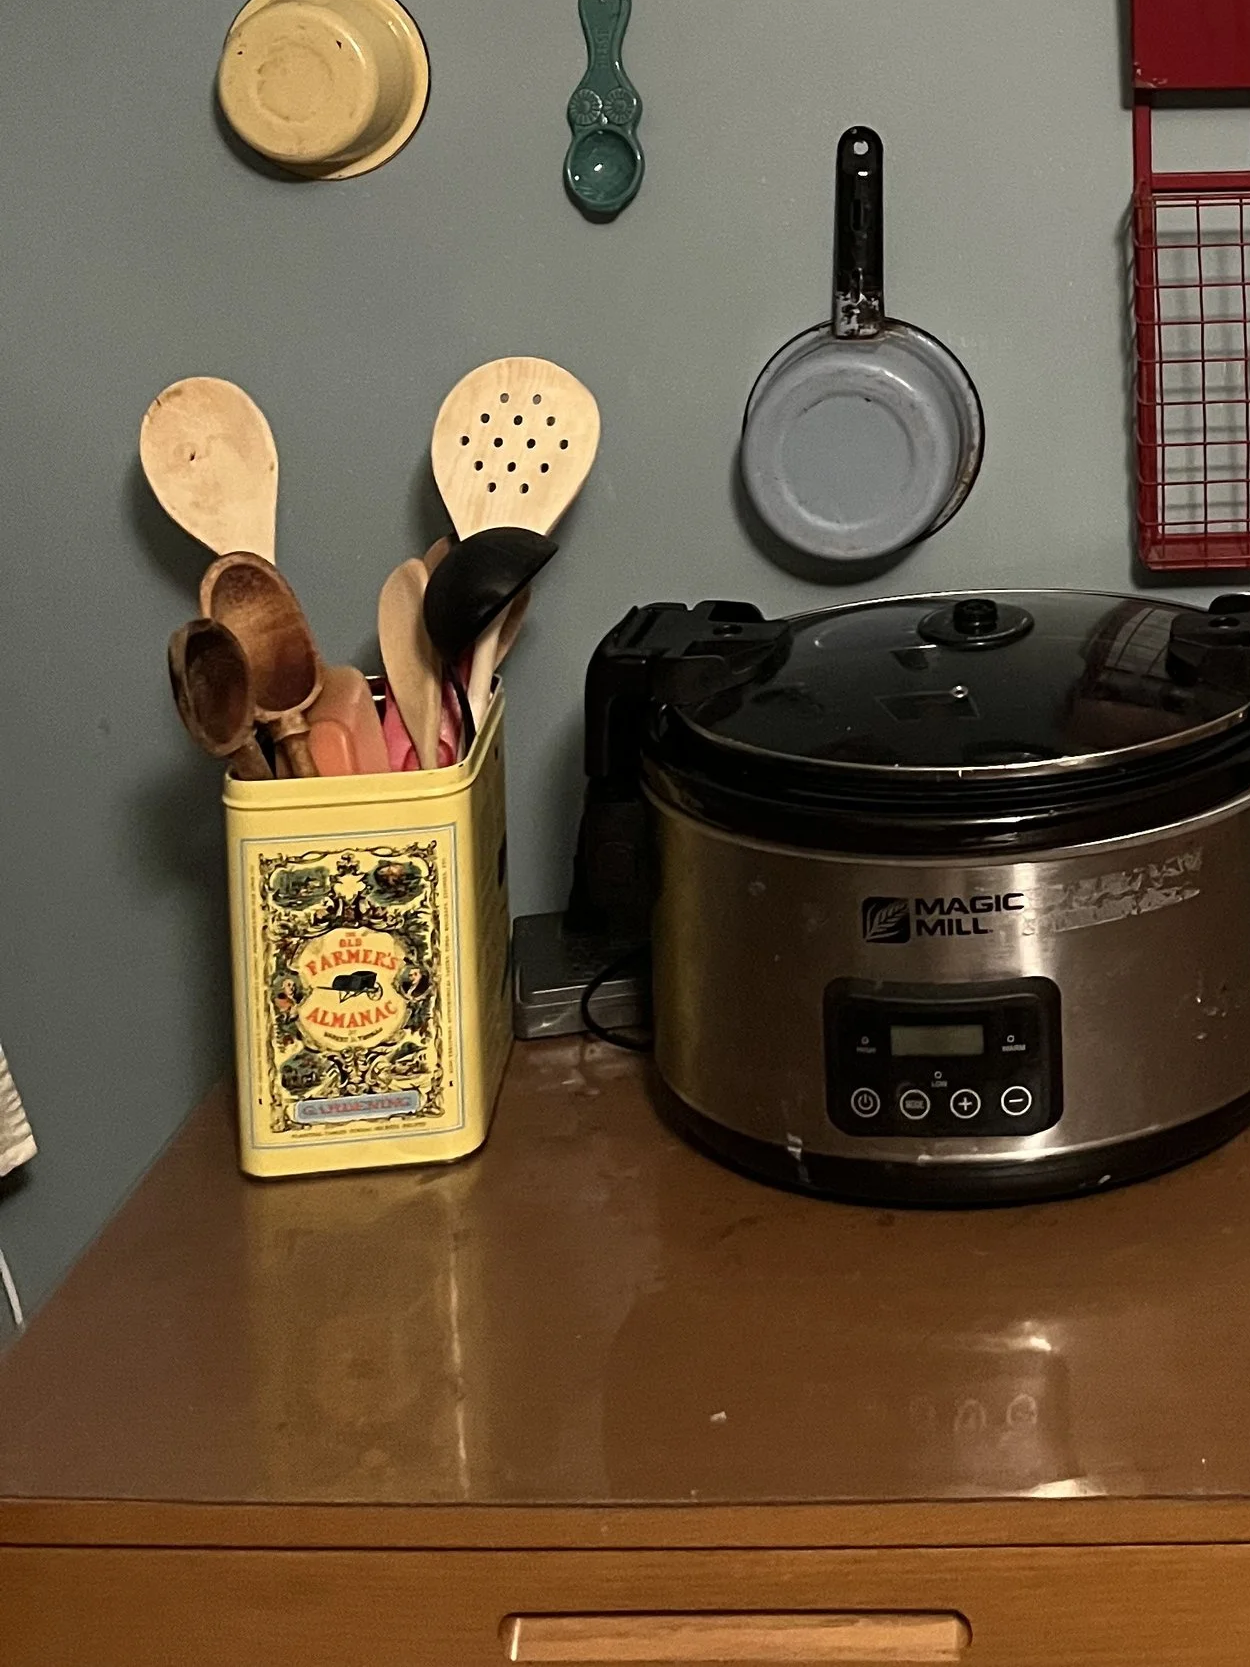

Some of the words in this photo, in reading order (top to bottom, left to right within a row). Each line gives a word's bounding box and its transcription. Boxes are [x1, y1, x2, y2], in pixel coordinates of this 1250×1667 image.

[915, 893, 1025, 916] MAGIC
[304, 949, 399, 977] FARMER'S
[305, 999, 398, 1029] ALMANAC
